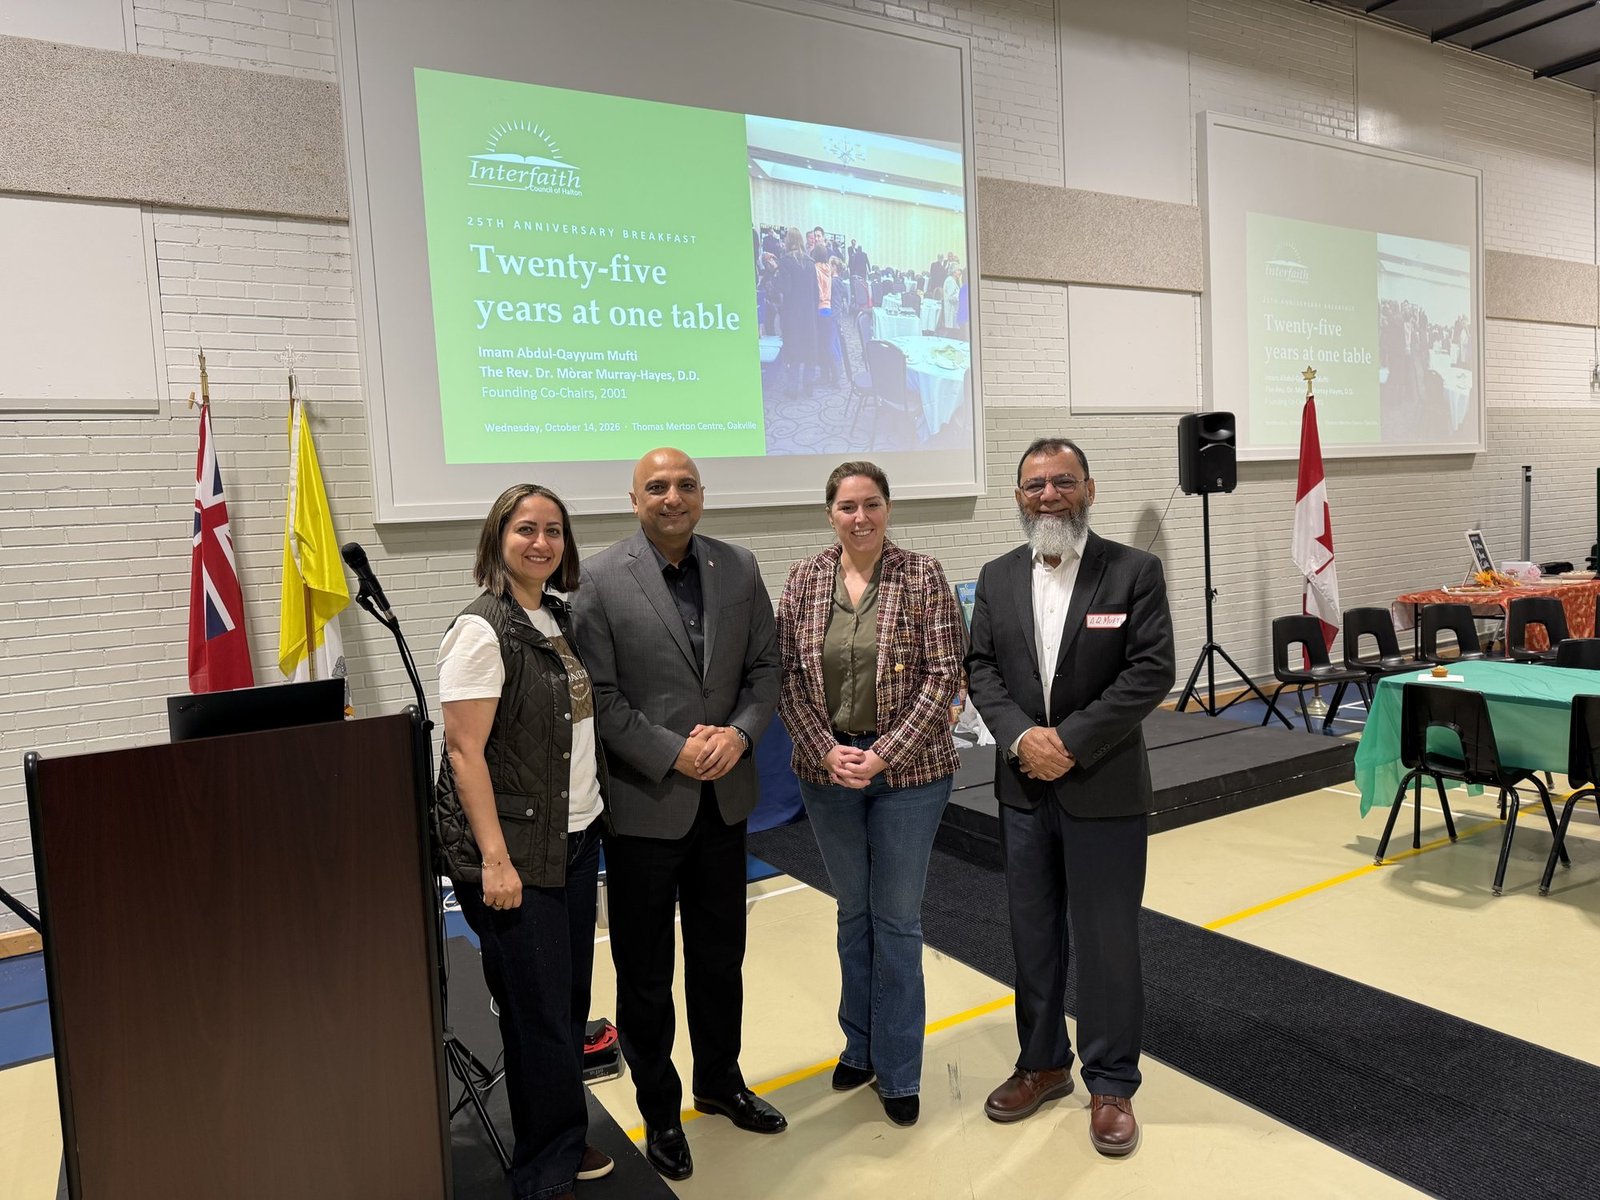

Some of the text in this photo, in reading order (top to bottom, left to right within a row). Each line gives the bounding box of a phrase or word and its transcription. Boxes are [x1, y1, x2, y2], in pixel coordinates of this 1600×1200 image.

[470, 160, 581, 189] Interfaith
[554, 187, 561, 195] of
[467, 216, 696, 244] 25TH ANNIVERSARY BREAKFAST
[470, 243, 669, 289] Twenty-five
[473, 299, 741, 331] years at one table
[1264, 313, 1342, 340] Twenty-five
[478, 346, 638, 363] Imam Abdul-Qayyum Mufti
[1263, 346, 1372, 365] years at one table
[479, 365, 700, 383] The Rev. Dr. Mòrar Murray-Hayes, D.D.
[481, 386, 628, 401] Founding Co-Chairs, 2001
[484, 421, 757, 434] Wednesday, October 14, 2026 Thomas Merton Centre, Oakville
